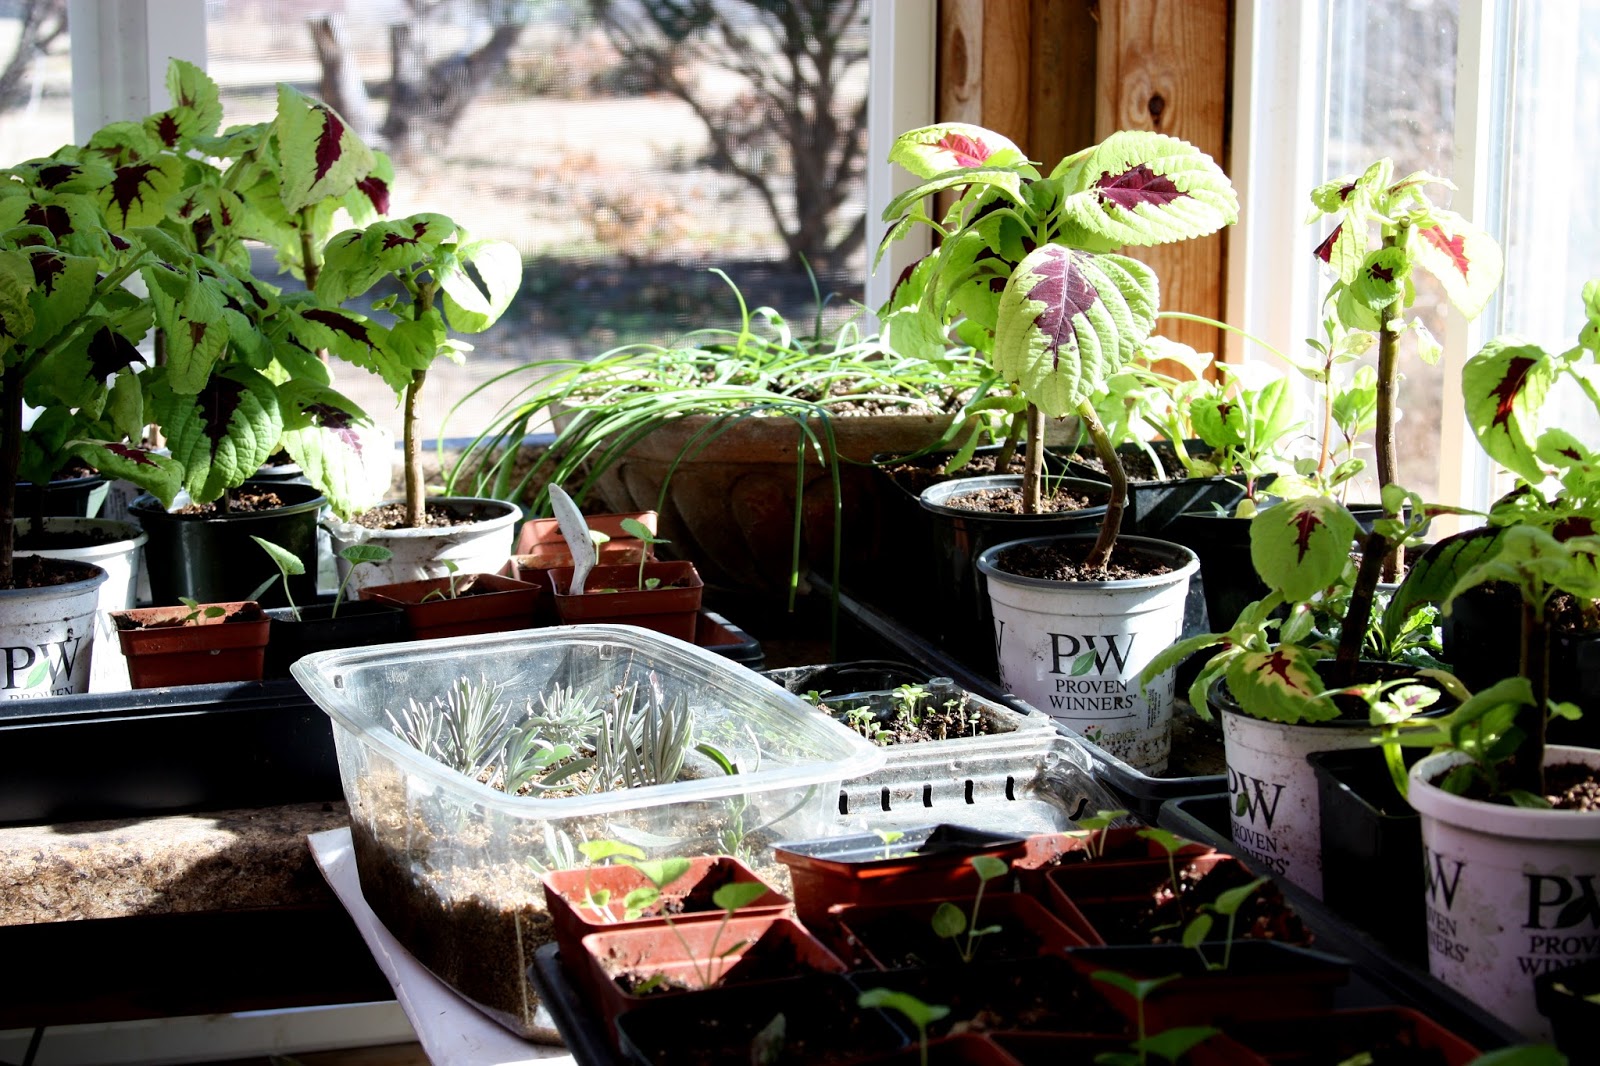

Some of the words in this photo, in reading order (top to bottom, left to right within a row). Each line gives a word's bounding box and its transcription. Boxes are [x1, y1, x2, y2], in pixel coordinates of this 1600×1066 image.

[0, 636, 82, 690] PW
[1046, 632, 1138, 676] PW
[1055, 679, 1128, 694] PROVEN
[1048, 694, 1135, 711] WINNERS
